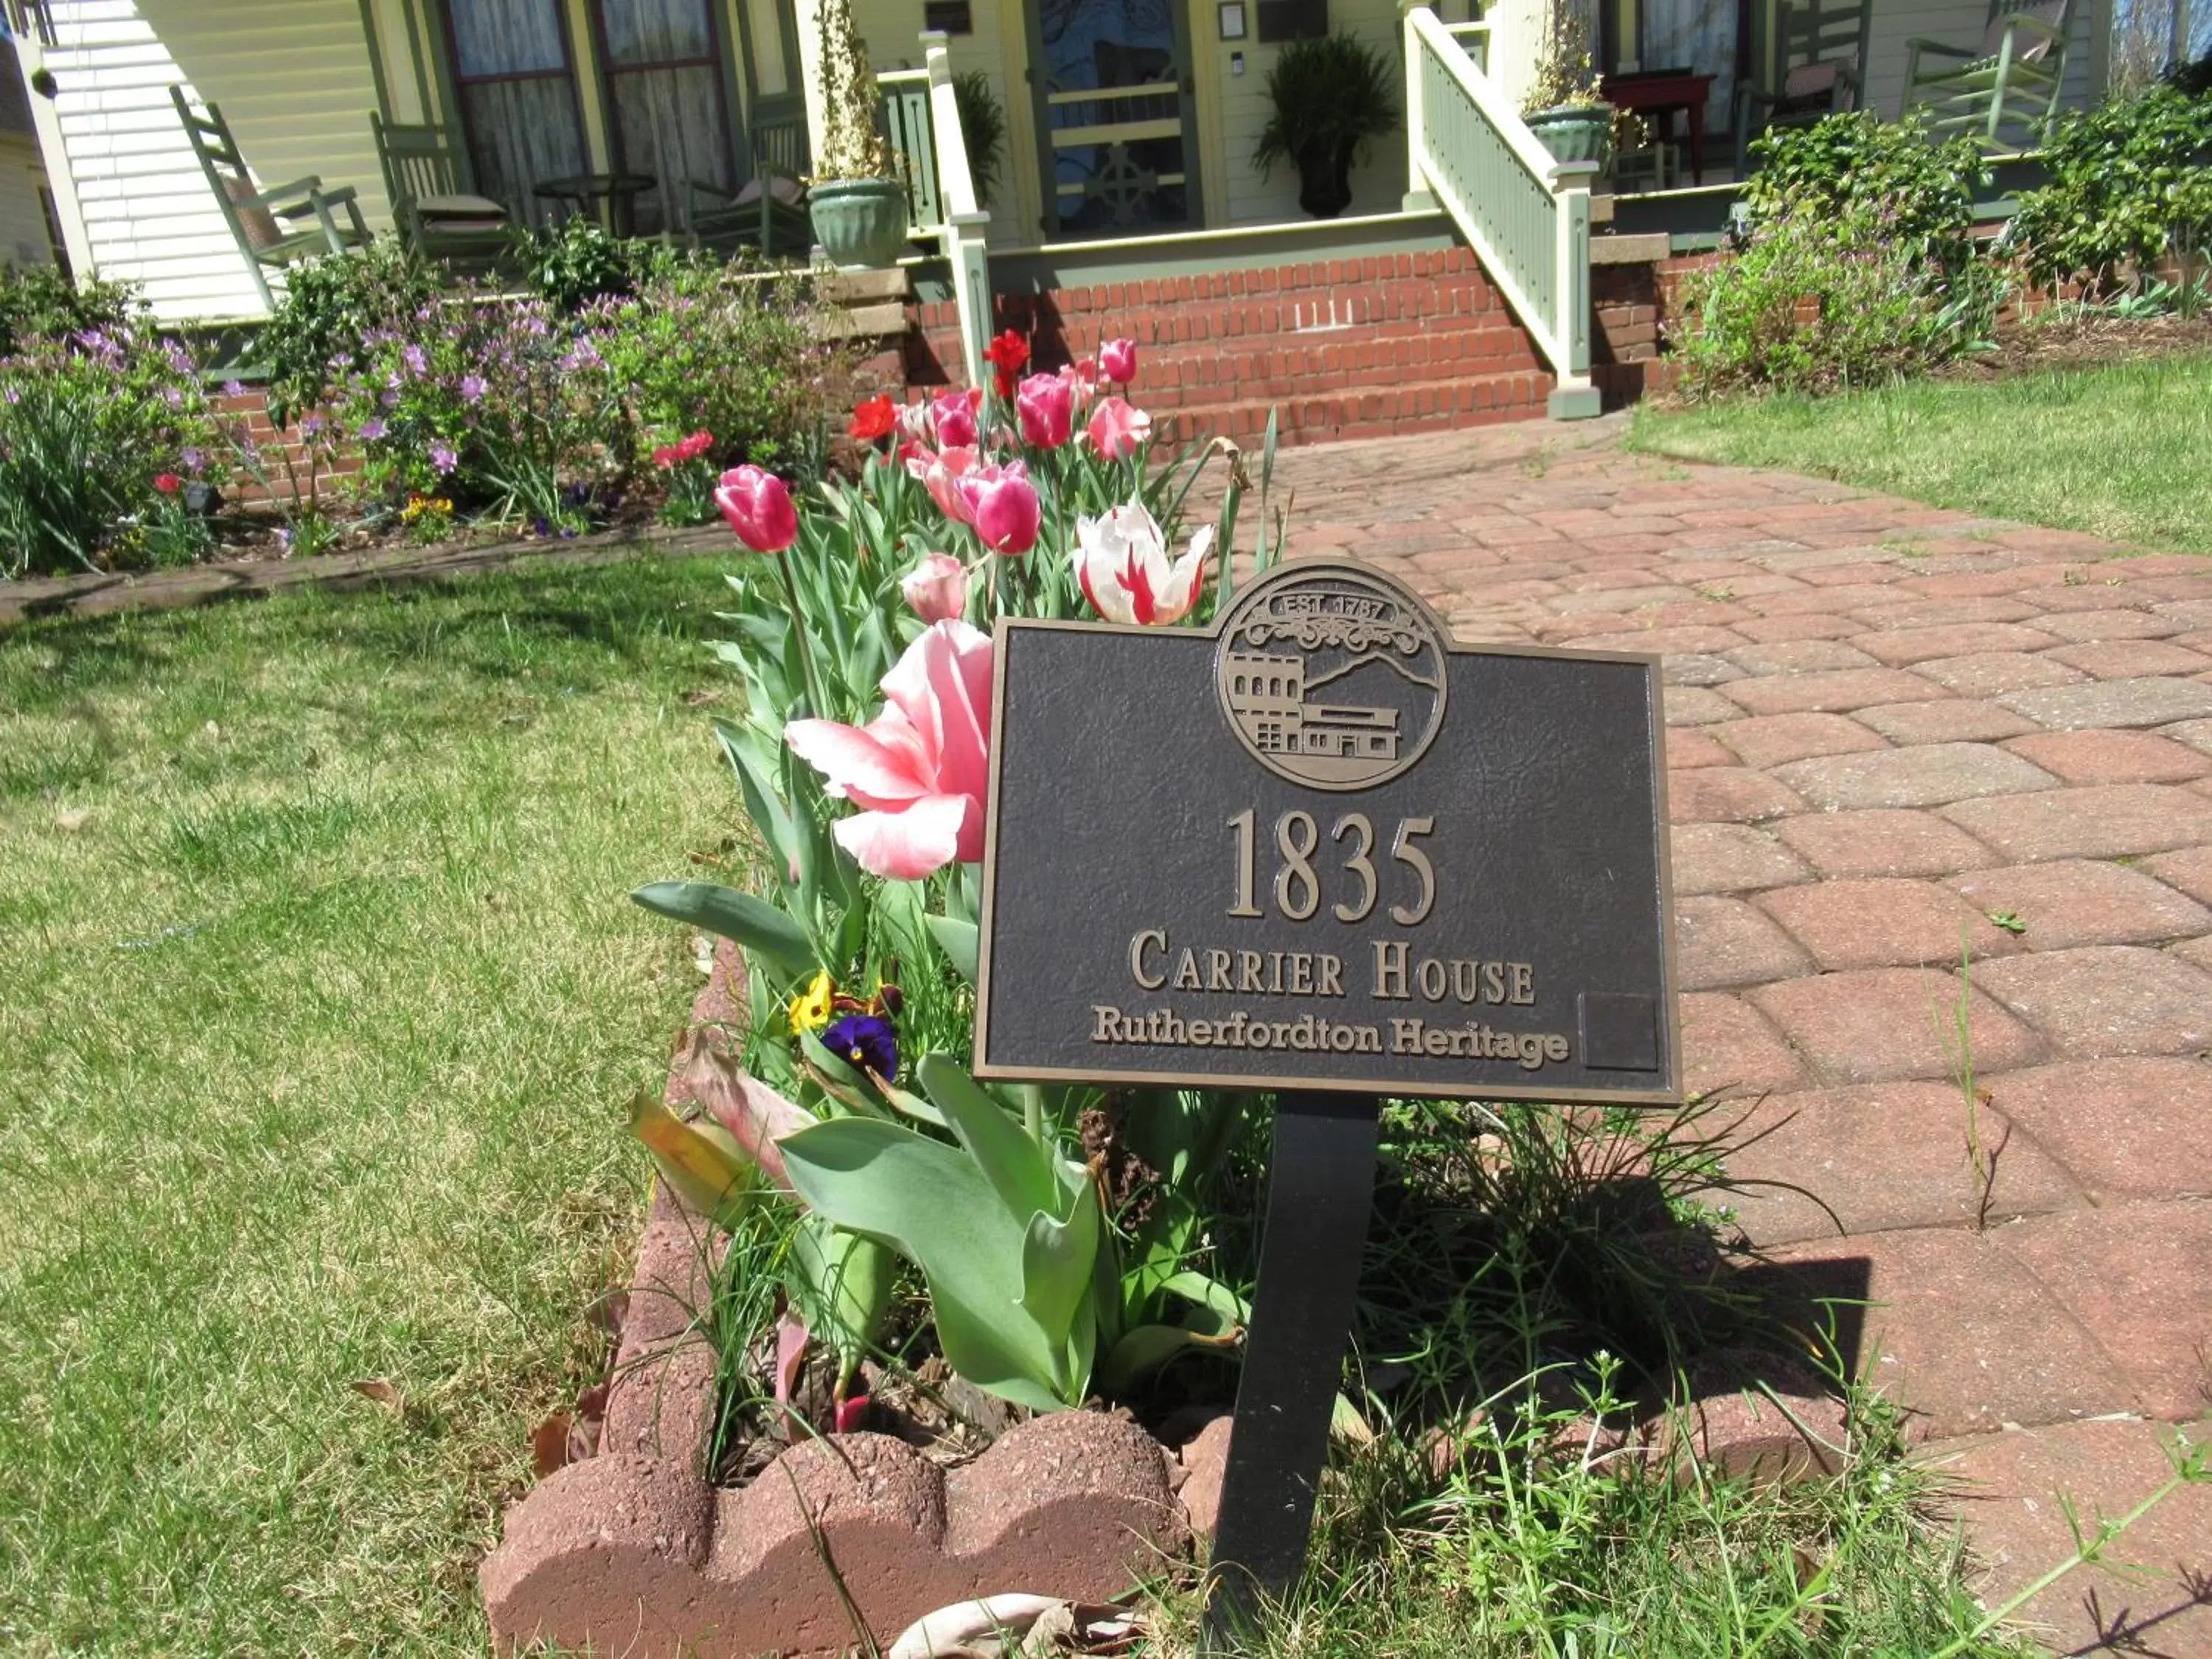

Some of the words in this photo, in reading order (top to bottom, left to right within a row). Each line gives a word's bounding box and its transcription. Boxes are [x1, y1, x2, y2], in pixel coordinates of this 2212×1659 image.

[1334, 597, 1385, 617] 1787
[1226, 808, 1436, 925] 1835
[1130, 930, 1346, 996] CARRIER
[1370, 939, 1536, 1004] HOUSE
[1091, 1005, 1382, 1053] Rutherfordton
[1392, 1018, 1570, 1068] Heritage
